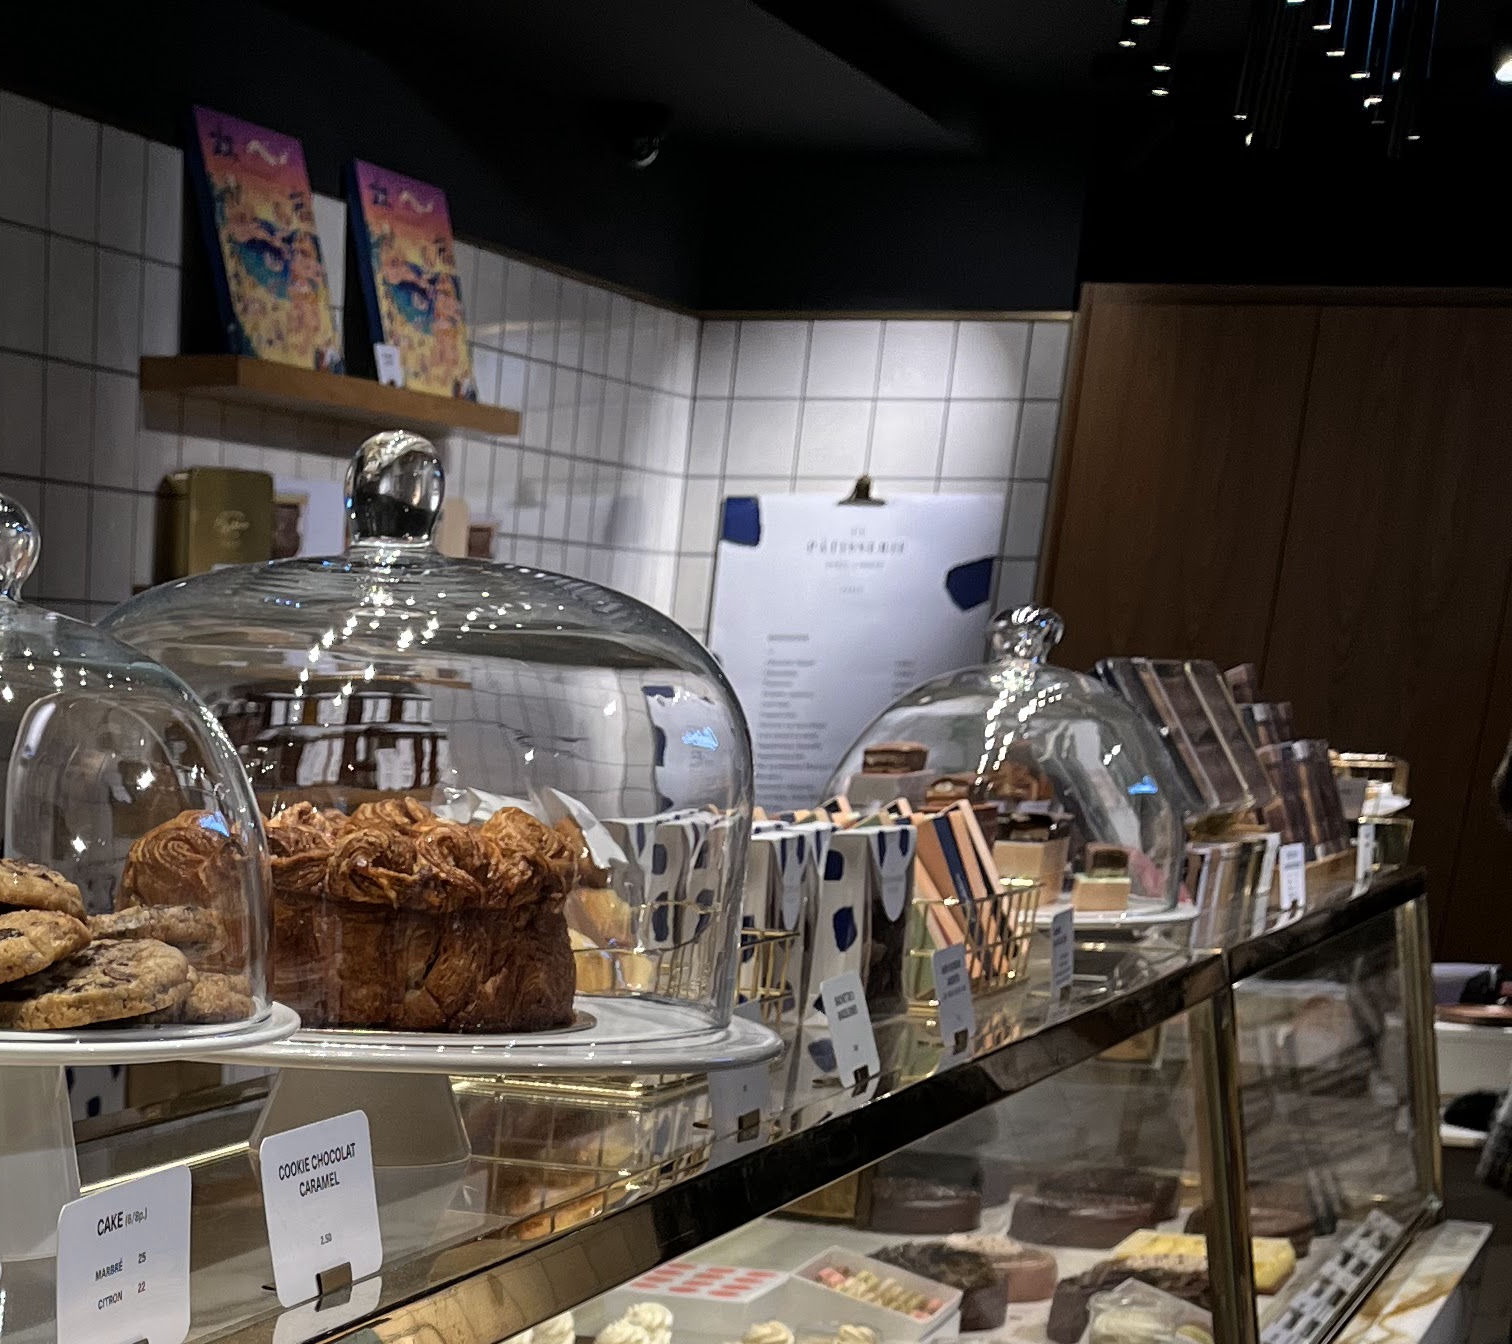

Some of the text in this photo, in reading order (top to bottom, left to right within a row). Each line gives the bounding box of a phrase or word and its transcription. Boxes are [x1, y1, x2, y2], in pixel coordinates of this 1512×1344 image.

[278, 1142, 355, 1181] COOKIE CHOCOLAT
[299, 1171, 340, 1197] CARAMEL
[97, 1211, 123, 1236] CAKE
[320, 1232, 332, 1245] 2.50
[95, 1251, 146, 1281] MARBRÉ 25
[98, 1281, 145, 1310] CITRON 22
